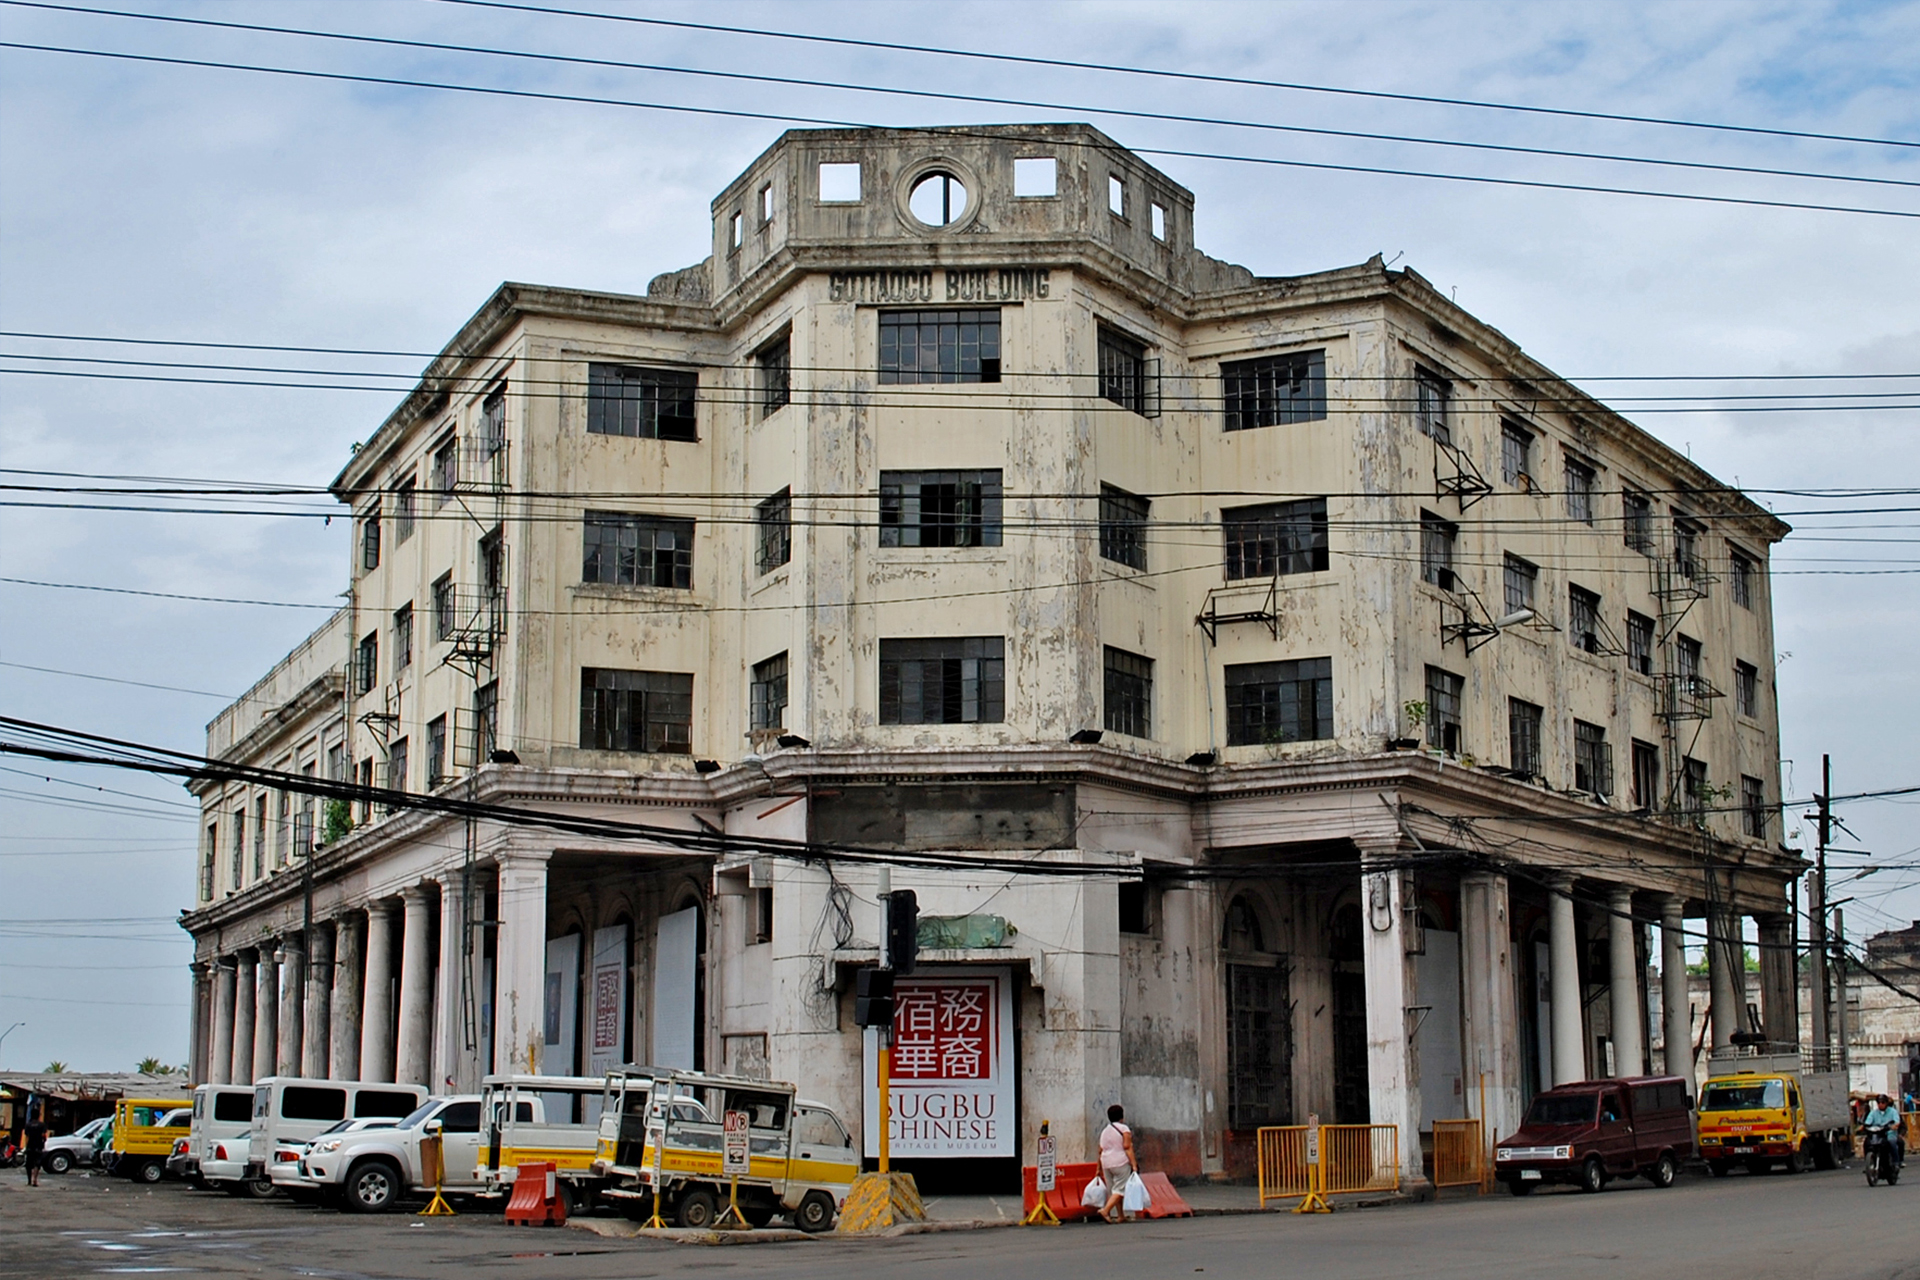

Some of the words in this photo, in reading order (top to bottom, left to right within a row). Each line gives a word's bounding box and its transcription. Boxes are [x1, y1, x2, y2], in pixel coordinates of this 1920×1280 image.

[945, 268, 1050, 300] BUILDING
[894, 987, 983, 1032] 宿務
[894, 1033, 982, 1078] 華裔
[725, 1112, 736, 1130] NO
